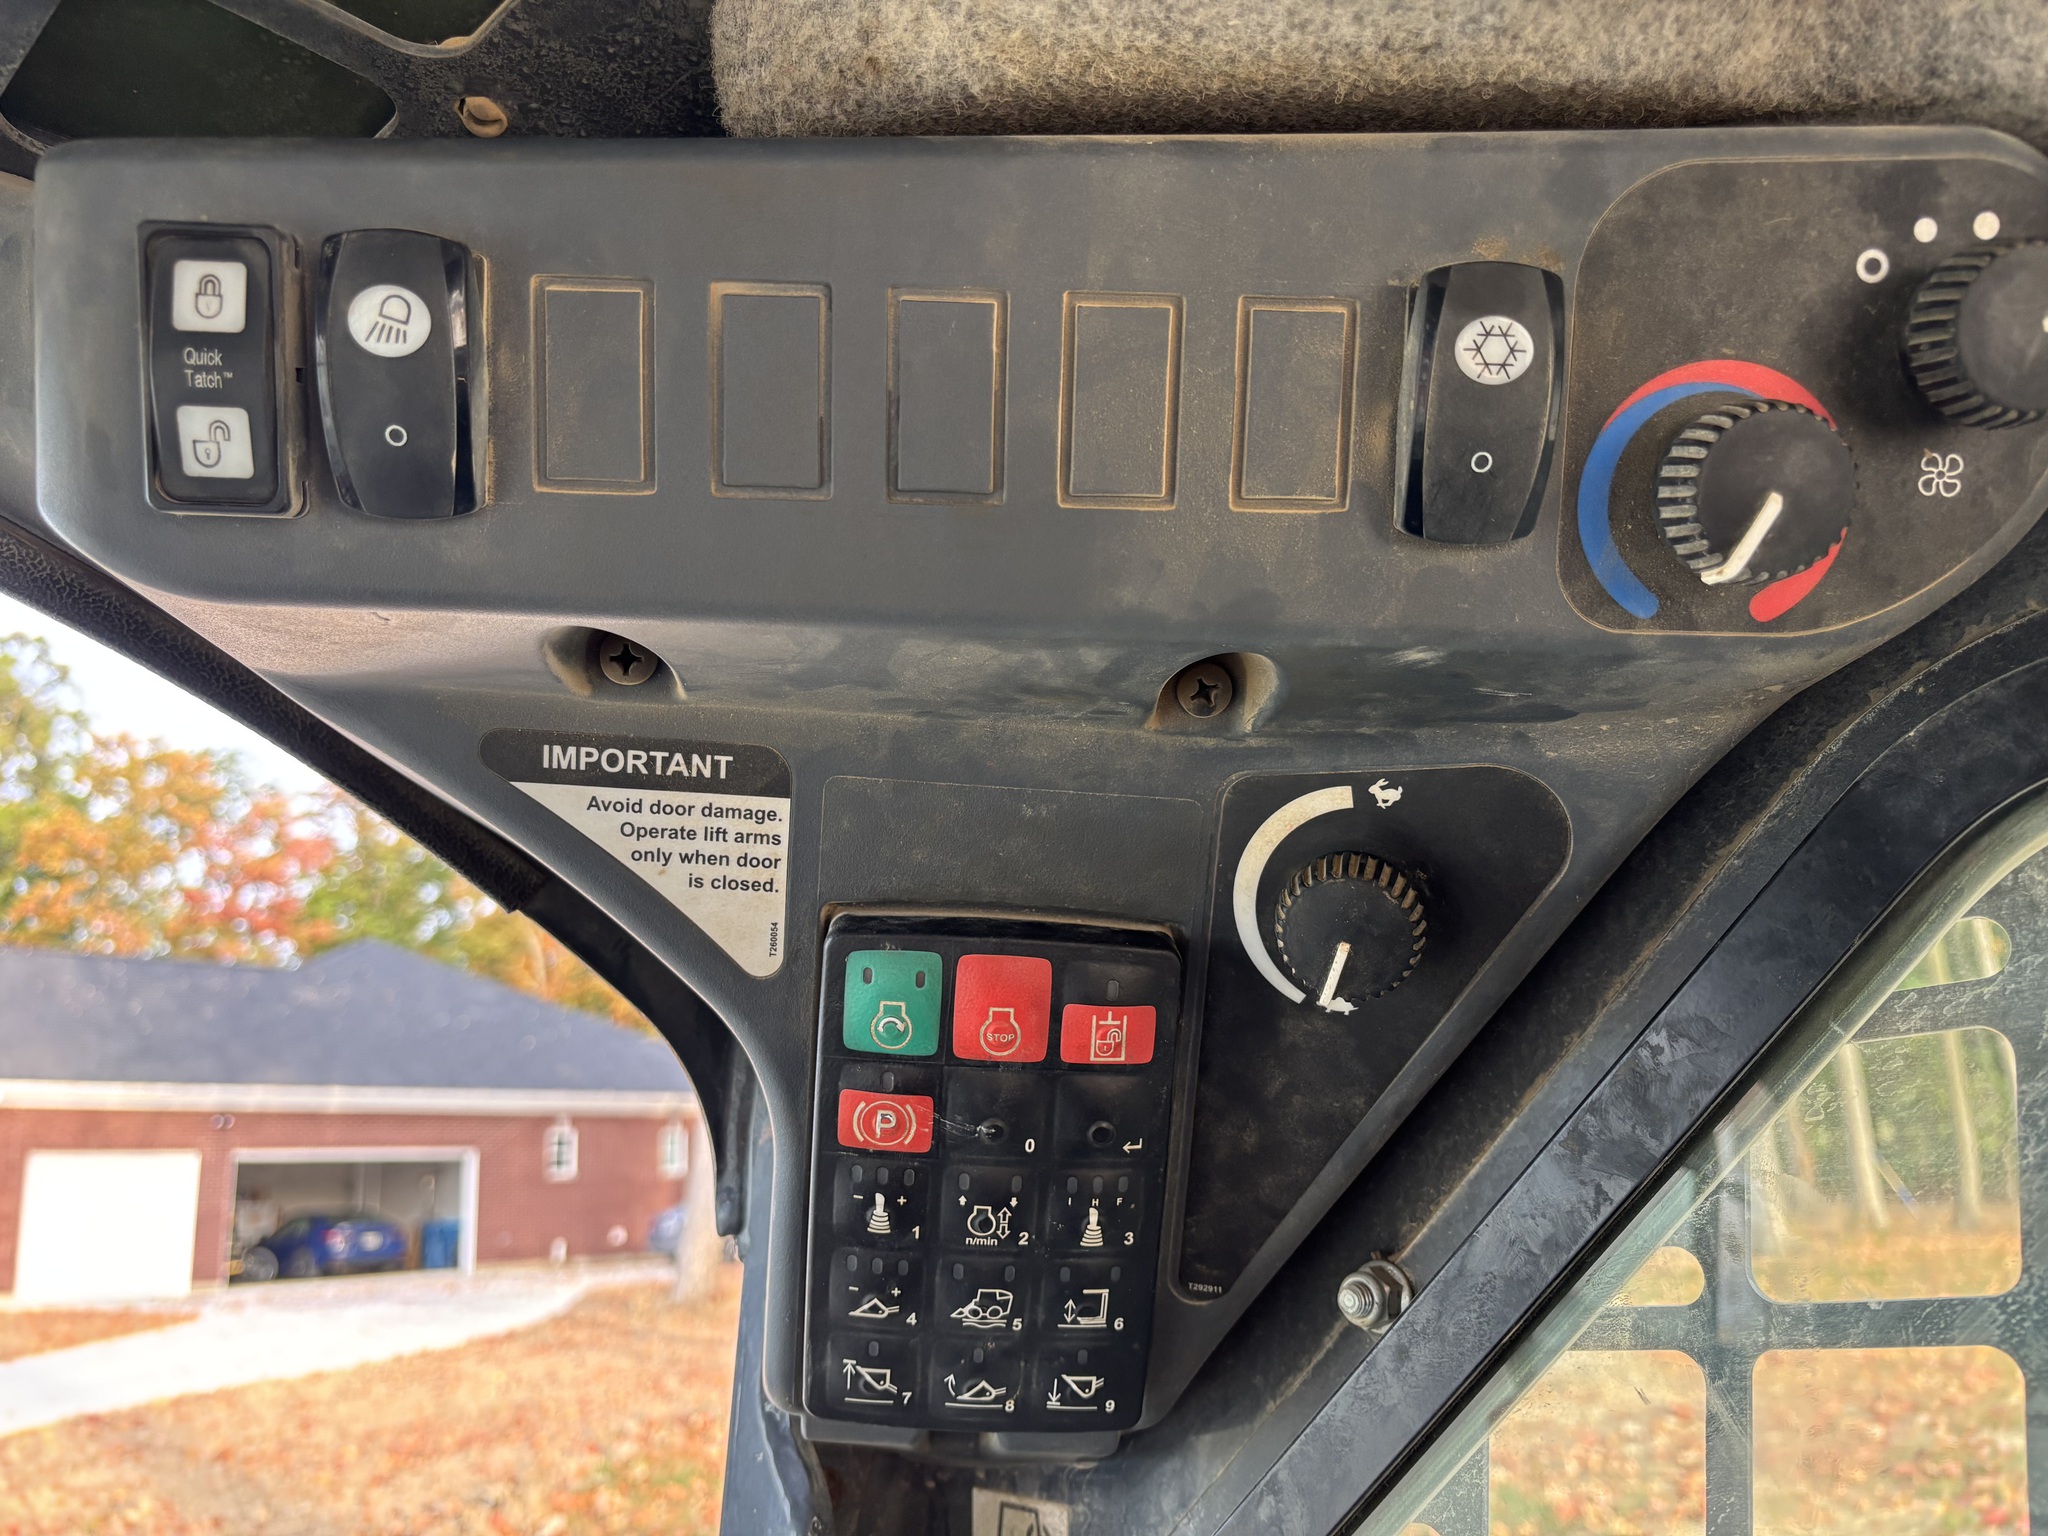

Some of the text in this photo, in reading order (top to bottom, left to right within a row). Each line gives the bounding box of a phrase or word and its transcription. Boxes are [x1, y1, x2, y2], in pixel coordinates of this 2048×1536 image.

[183, 347, 222, 366] Quick
[542, 744, 734, 780] IMPORTANT
[586, 795, 783, 825] Avoid door damage.
[620, 821, 782, 847] Operate lift arms
[631, 848, 782, 870] only when door
[688, 873, 780, 894] is closed.
[769, 921, 779, 958] T260054
[986, 1032, 1015, 1043] STOP
[876, 1110, 897, 1139] P
[1091, 1198, 1100, 1207] H
[911, 1225, 920, 1240] 1
[1018, 1232, 1030, 1246] 2
[1123, 1232, 1134, 1246] 3
[965, 1235, 998, 1247] n/min
[906, 1312, 918, 1326] 4
[1012, 1318, 1022, 1332] 5
[1114, 1317, 1124, 1331] 6
[902, 1392, 912, 1406] 7
[1004, 1399, 1015, 1412] 8
[1104, 1400, 1116, 1412] 9
